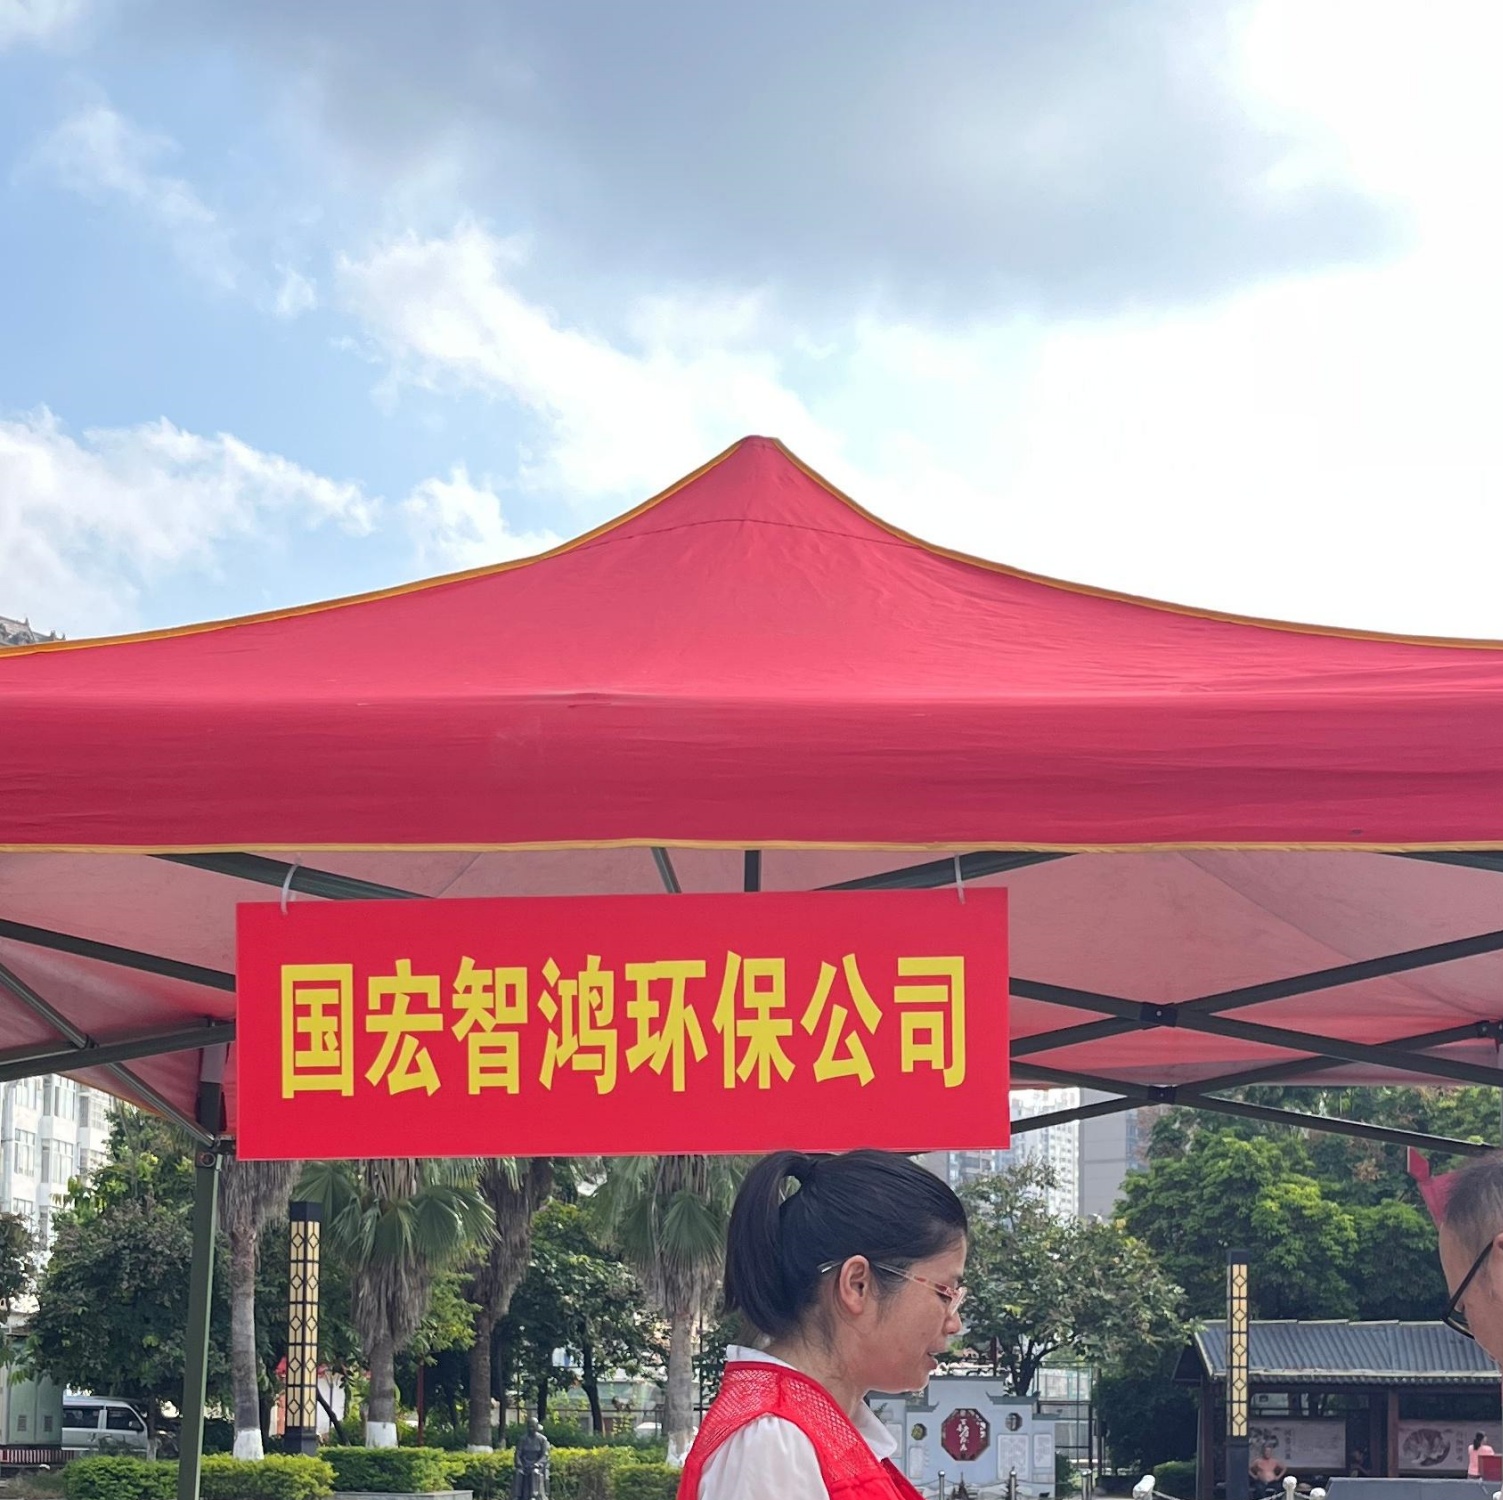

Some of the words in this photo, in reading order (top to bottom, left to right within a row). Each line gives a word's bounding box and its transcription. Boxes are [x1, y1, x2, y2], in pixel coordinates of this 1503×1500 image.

[280, 950, 967, 1100] 国宏智鸿环保公司
